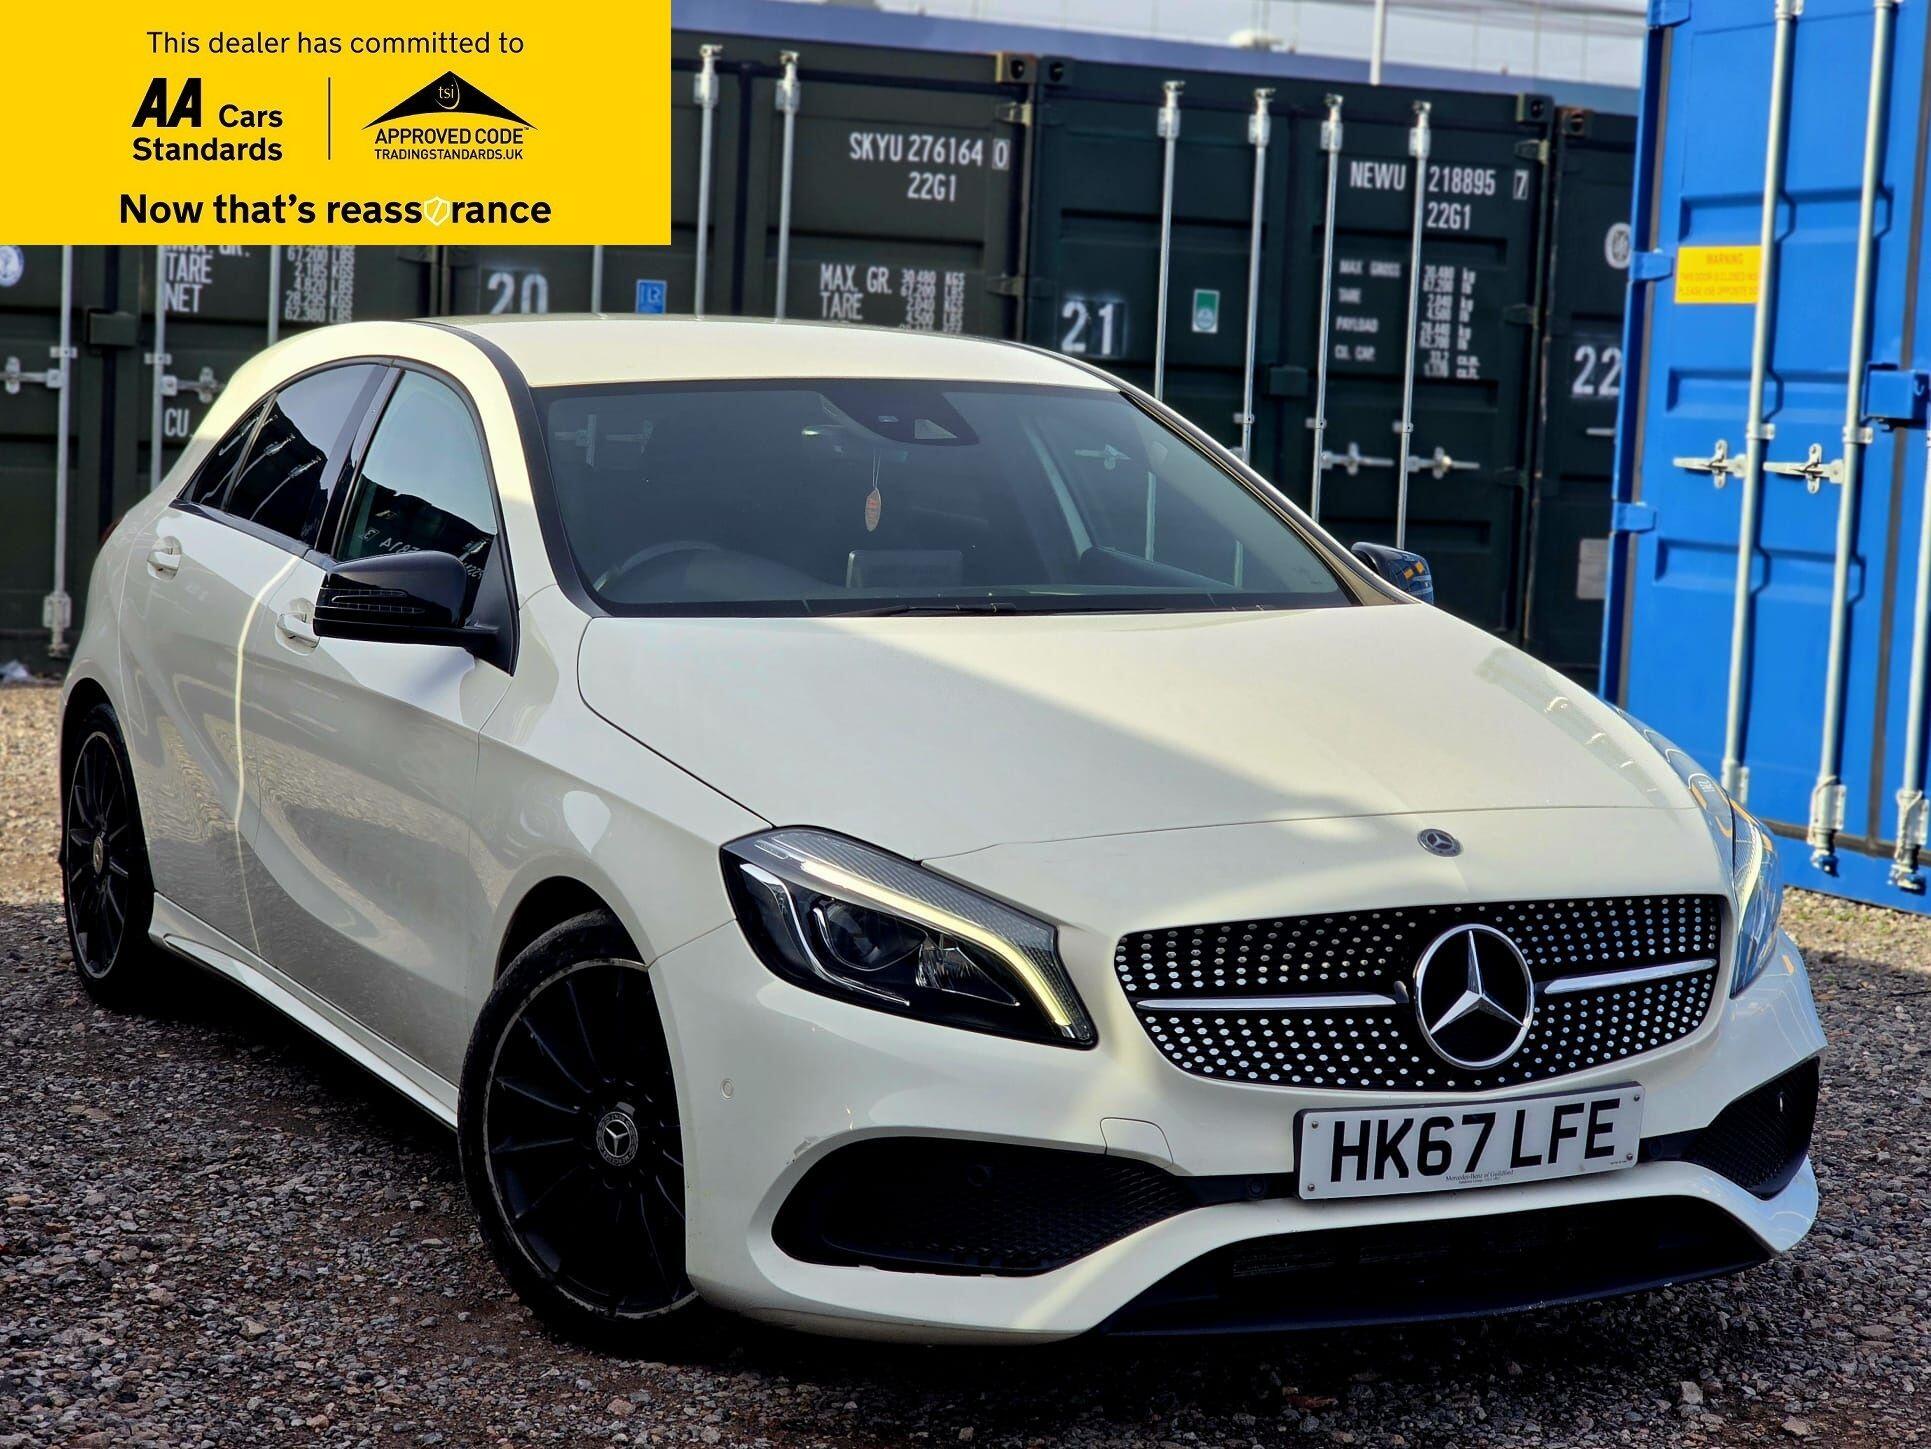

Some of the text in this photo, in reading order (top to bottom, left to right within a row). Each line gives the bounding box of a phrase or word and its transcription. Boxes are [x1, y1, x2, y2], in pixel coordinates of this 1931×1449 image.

[850, 133, 1009, 169] SKYU 276164 0
[907, 172, 956, 201] 22G1
[1350, 161, 1528, 199] NEWU 218895 7
[1426, 202, 1471, 231] 22G1
[166, 252, 213, 283] TARE
[820, 263, 859, 292] MAX.
[866, 266, 893, 294] GR.
[164, 283, 203, 313] NET
[488, 272, 548, 314] 20
[820, 292, 864, 320] TARE
[1061, 300, 1114, 354] 21
[1572, 346, 1622, 395] 22
[1330, 1097, 1621, 1183] HK67 LFE
